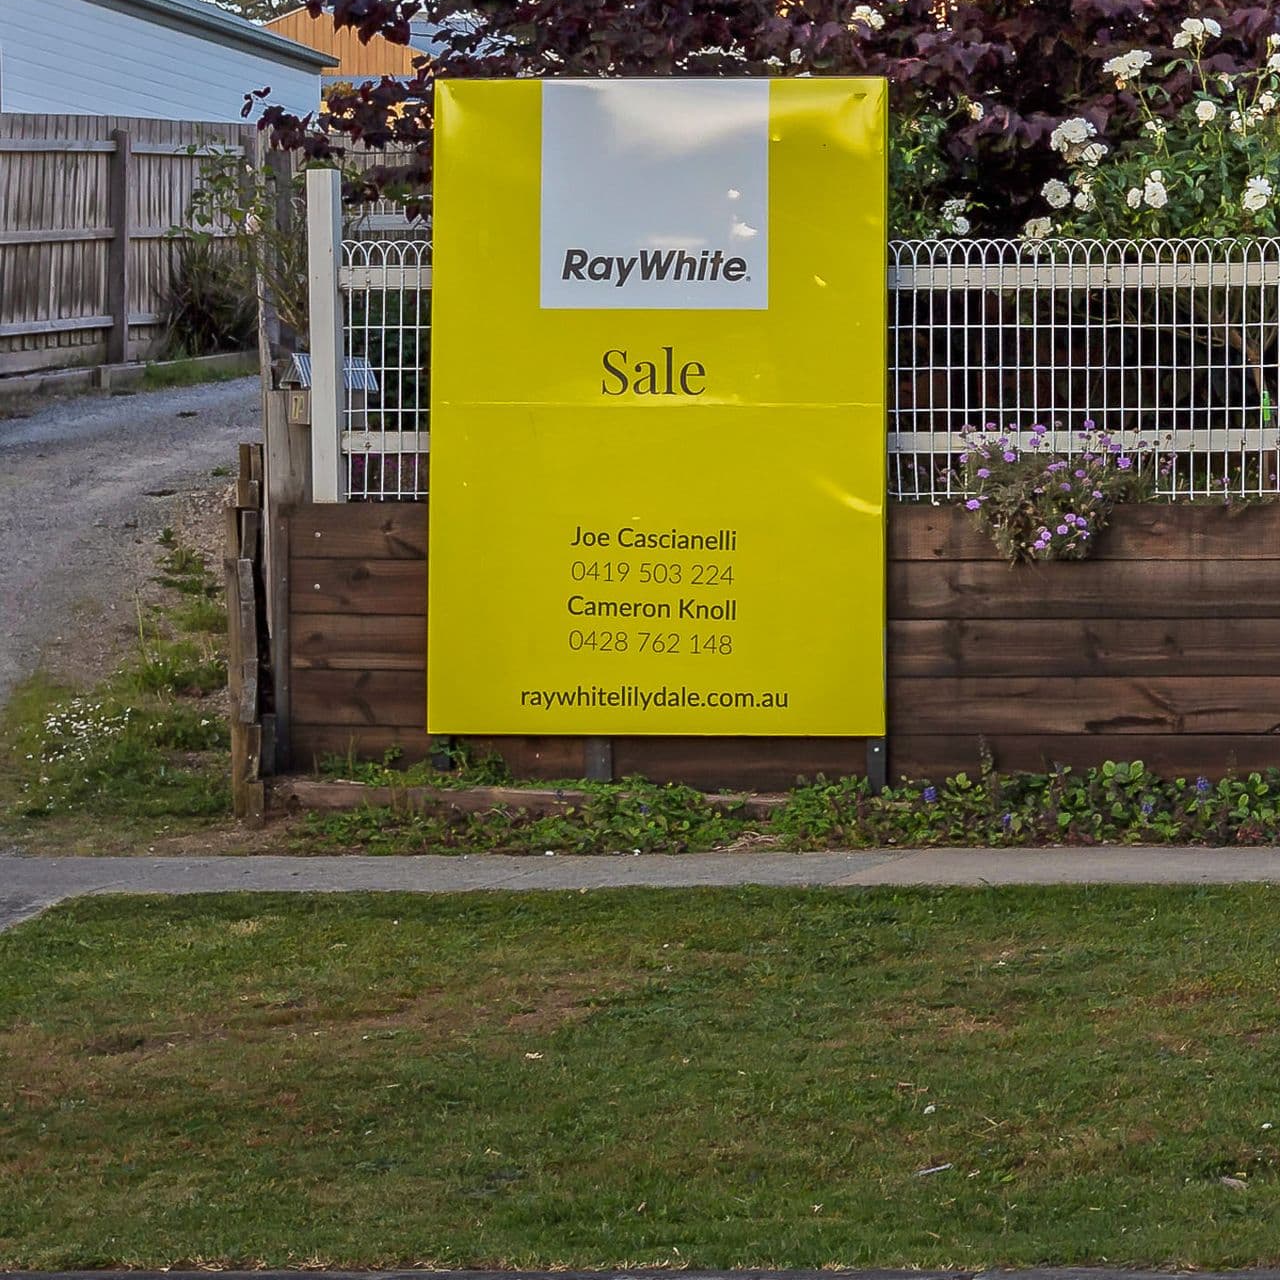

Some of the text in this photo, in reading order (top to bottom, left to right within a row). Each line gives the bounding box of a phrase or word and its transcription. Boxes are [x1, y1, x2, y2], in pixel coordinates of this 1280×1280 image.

[601, 346, 706, 396] Sale
[570, 526, 737, 552] Joe Cascianelli
[571, 560, 735, 587] 0419 503 224
[567, 595, 737, 621] Cameron Knoll
[568, 629, 733, 656] 0428 762 148
[520, 685, 788, 712] raywhitelilydale.com.au
